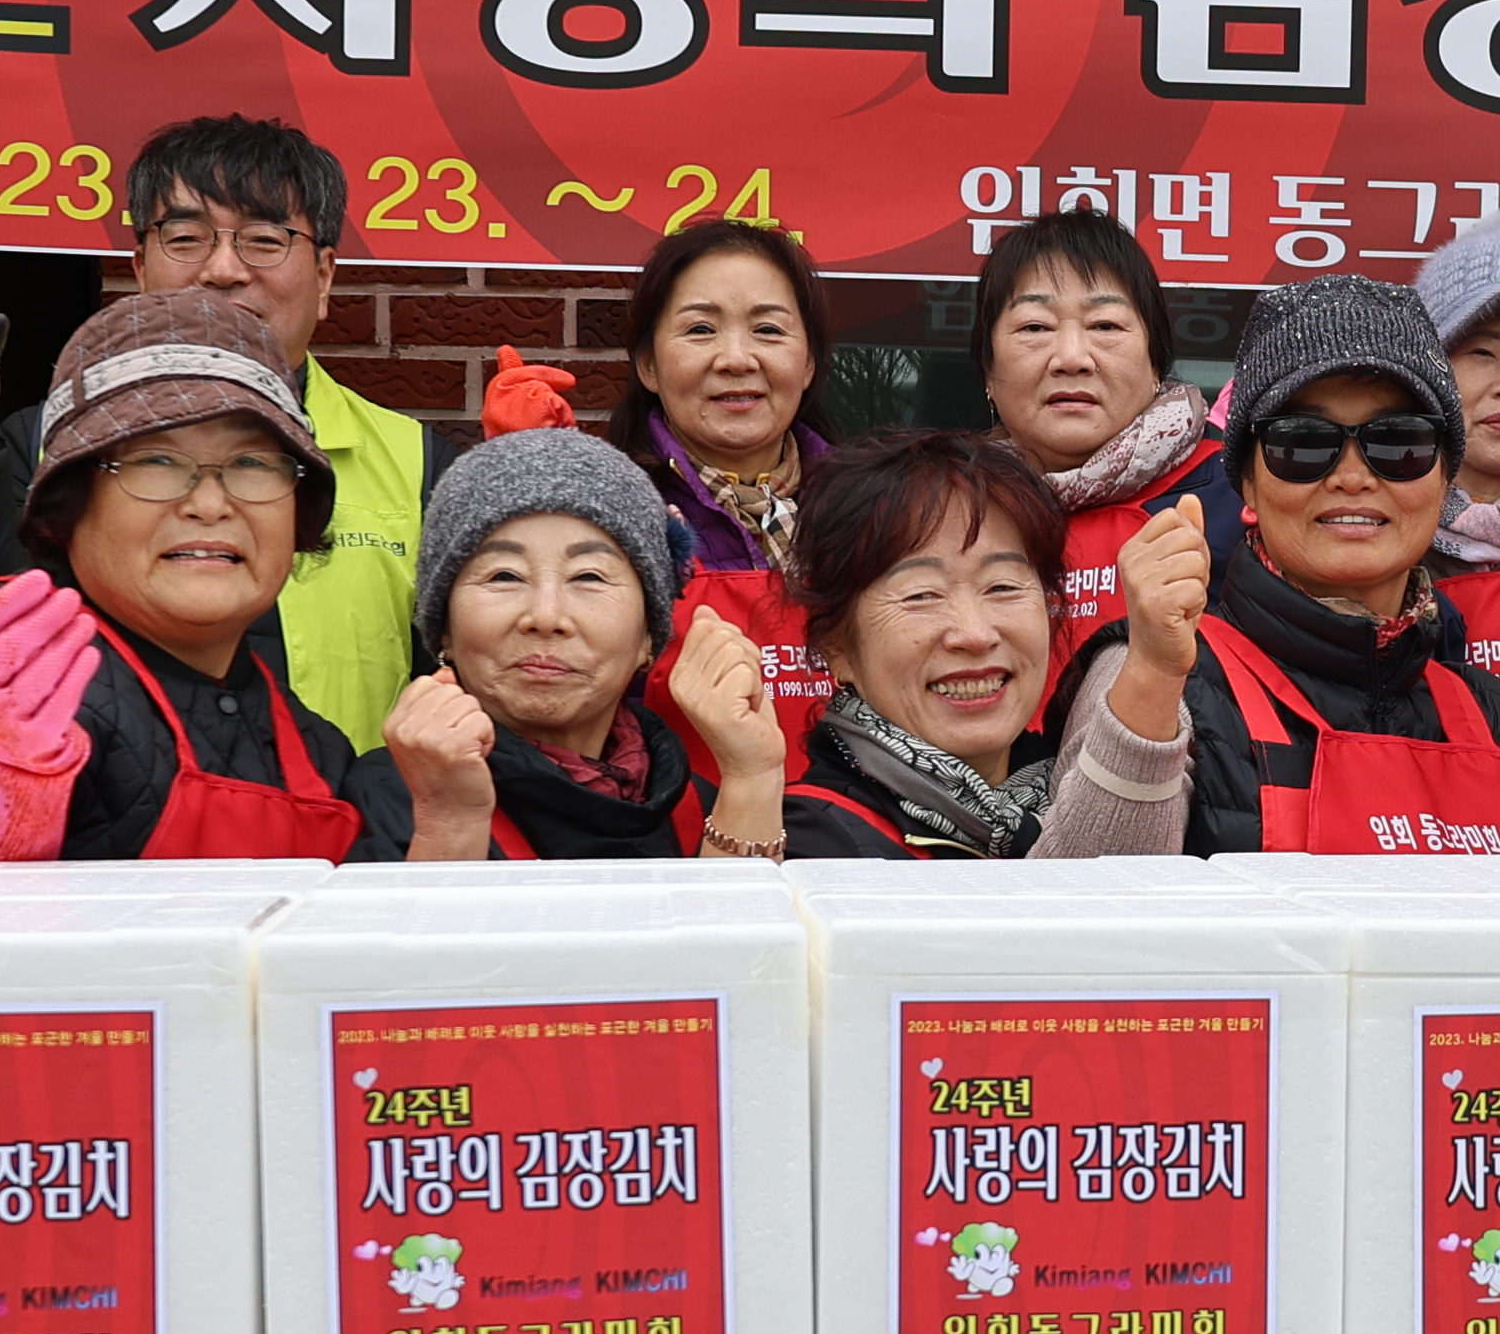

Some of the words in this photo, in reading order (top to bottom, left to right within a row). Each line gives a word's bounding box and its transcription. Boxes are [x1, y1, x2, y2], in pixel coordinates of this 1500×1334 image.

[364, 155, 507, 239] 23.
[1065, 564, 1117, 600] 라미회
[1368, 815, 1418, 851] 임회
[906, 1020, 946, 1034] 2023.
[947, 1019, 988, 1034] 나눔과
[989, 1019, 1029, 1033] 배려로
[1032, 1018, 1059, 1033] 이웃
[1060, 1018, 1100, 1034] 사랑을
[1102, 1017, 1154, 1033] 실천하는
[1156, 1017, 1196, 1033] 포근한
[1198, 1017, 1224, 1032] 겨울
[1226, 1017, 1264, 1032] 만들기
[366, 1085, 472, 1128] 24주년
[931, 1077, 1031, 1118] 24주년
[362, 1133, 503, 1216] 사랑의
[515, 1125, 697, 1209] 김장김치
[924, 1125, 1058, 1205] 사랑의
[1072, 1121, 1244, 1202] 김장김치
[594, 1267, 686, 1294] KIMCHI
[1145, 1262, 1232, 1285] KIMCHI
